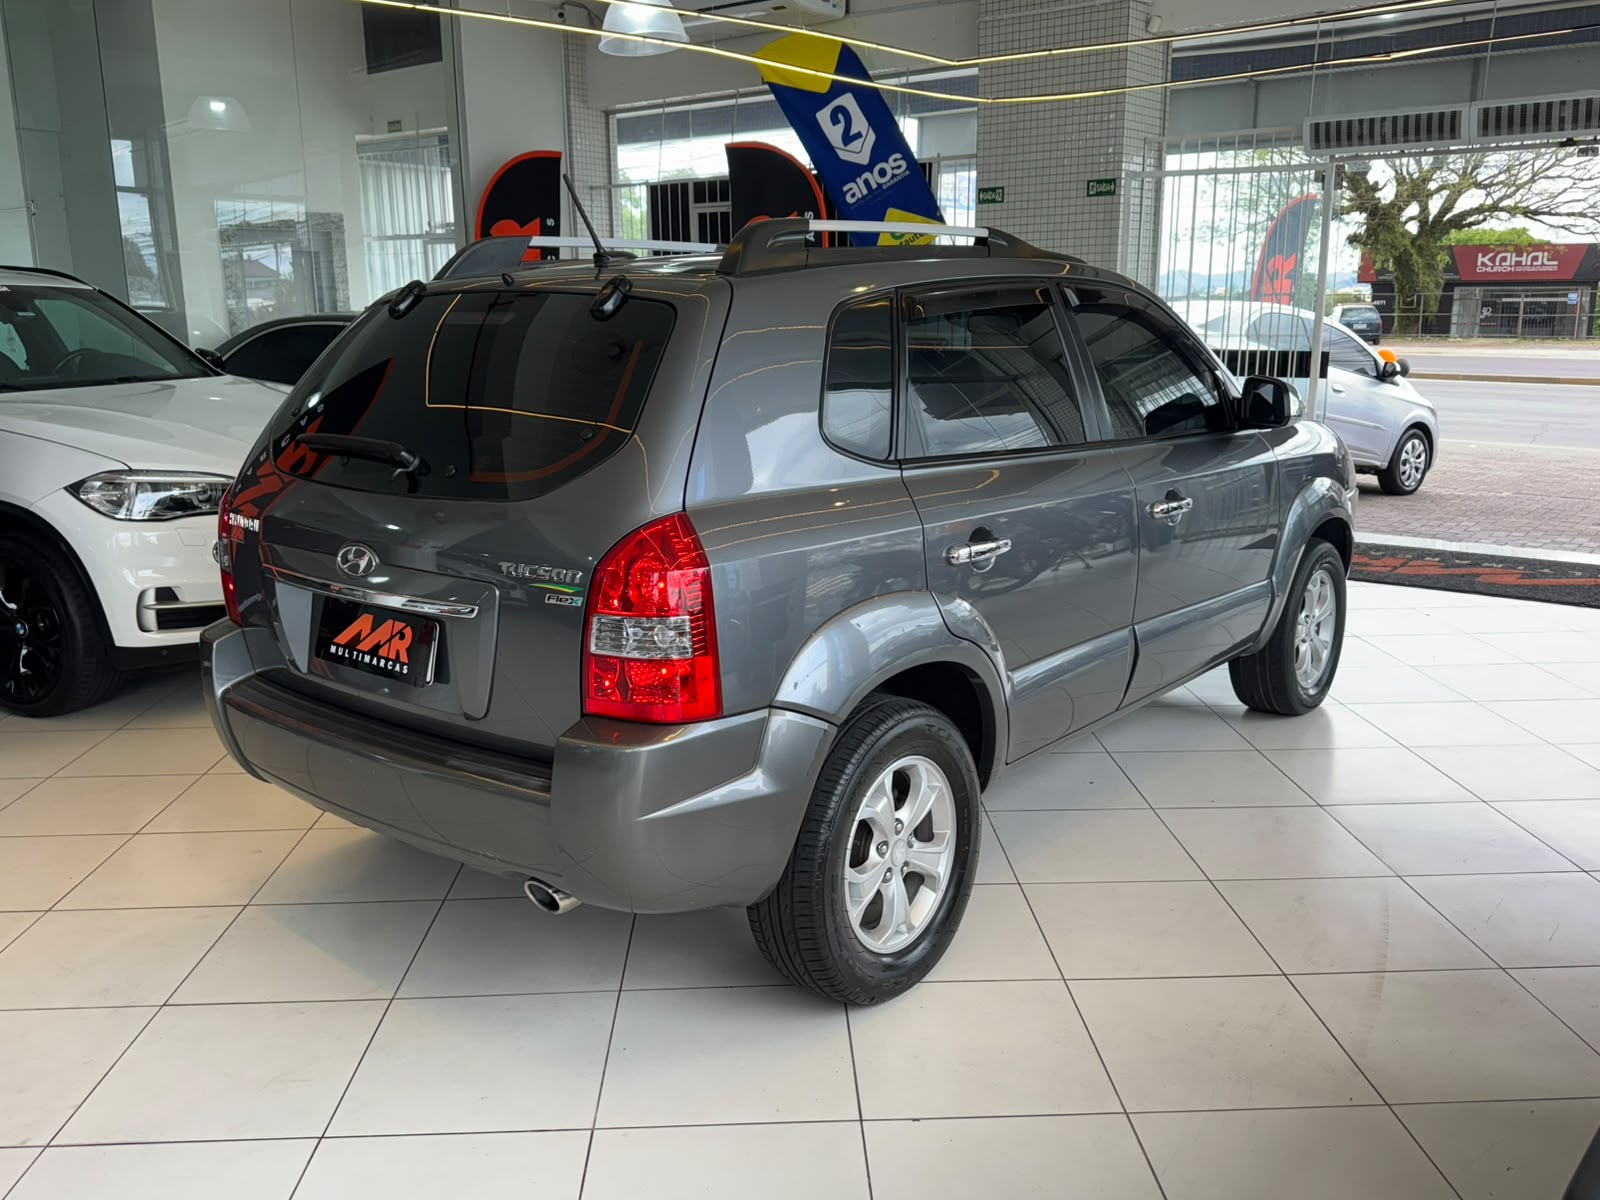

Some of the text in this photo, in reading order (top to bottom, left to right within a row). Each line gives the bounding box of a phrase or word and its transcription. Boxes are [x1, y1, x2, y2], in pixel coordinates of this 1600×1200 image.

[829, 104, 864, 148] 2
[842, 152, 908, 204] anos
[882, 169, 911, 190] GARANTIA
[1476, 265, 1515, 273] CHURCH
[1477, 251, 1559, 266] KAHAL
[329, 644, 409, 674] MULTIMARCAS
